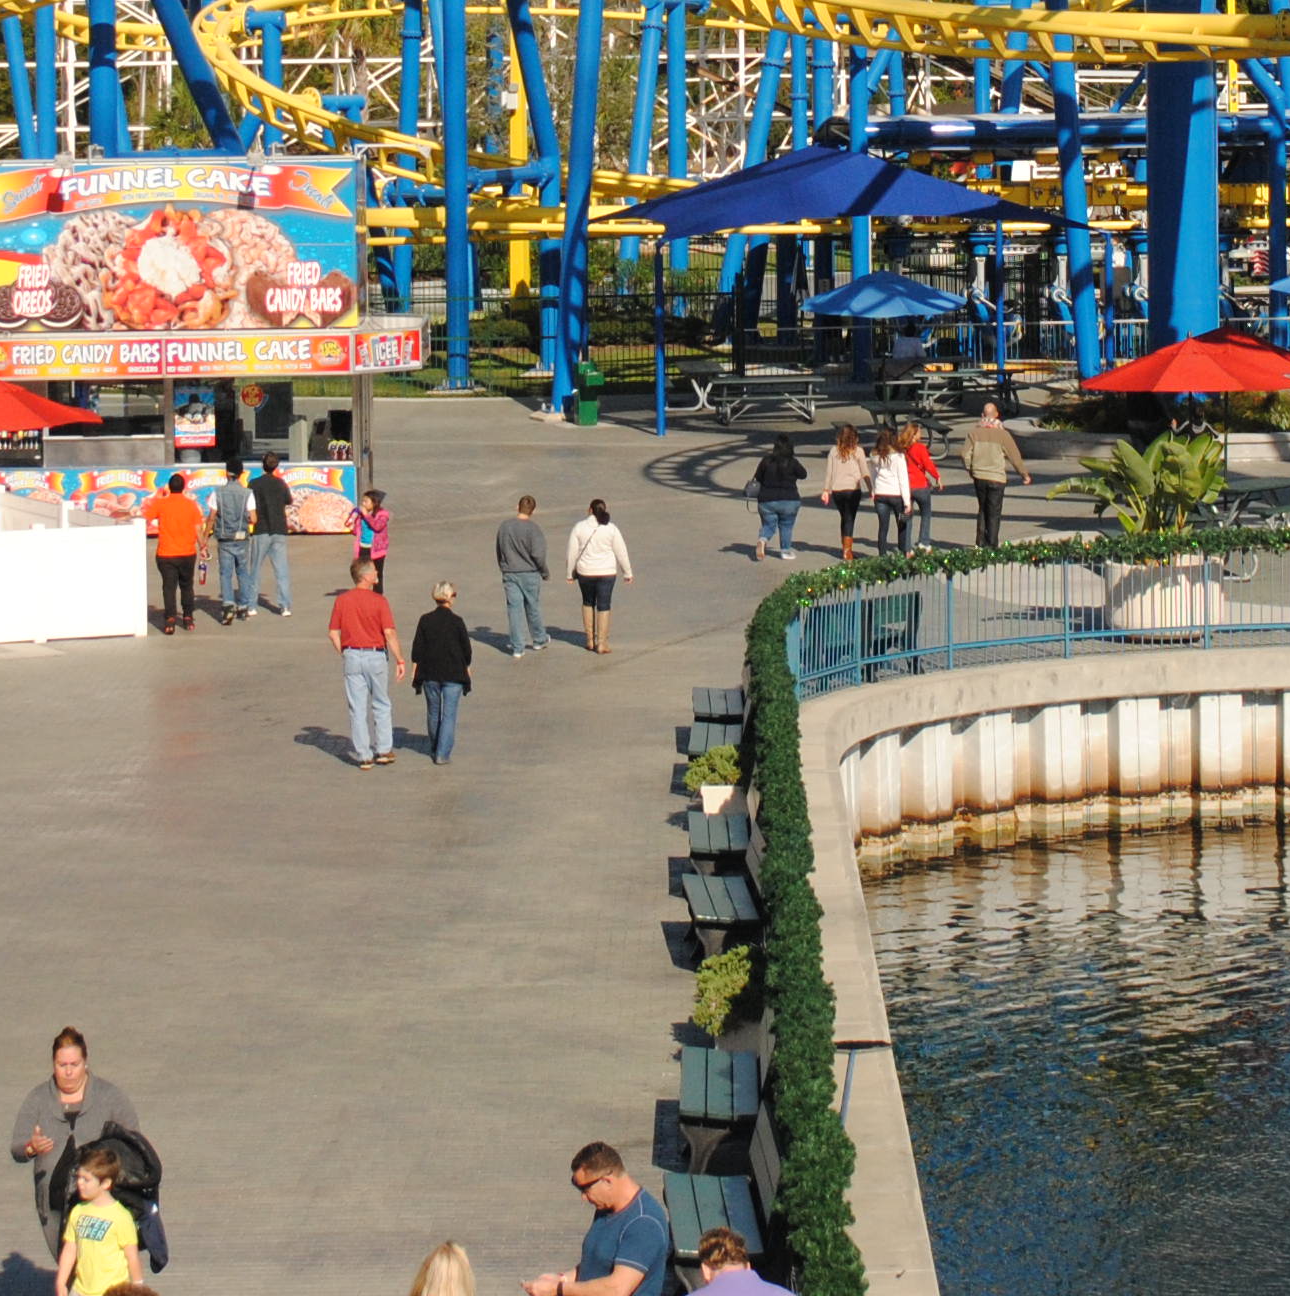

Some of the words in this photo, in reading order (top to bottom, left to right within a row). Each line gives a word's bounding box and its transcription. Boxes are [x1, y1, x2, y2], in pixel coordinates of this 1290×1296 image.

[61, 167, 181, 201] FUNNEL
[186, 168, 272, 198] CAKE
[18, 265, 50, 288] FRIED
[287, 261, 320, 285] FRIED
[13, 289, 52, 314] OREOS
[265, 287, 307, 312] CANDY
[310, 287, 342, 312] BARS
[12, 345, 56, 365] FRIED
[62, 344, 113, 364] CANDY
[120, 342, 161, 364] BARS
[166, 341, 248, 363] FUNNEL
[254, 339, 312, 361] CAKE
[376, 340, 399, 361] ICEE
[77, 1215, 113, 1230] SUPER
